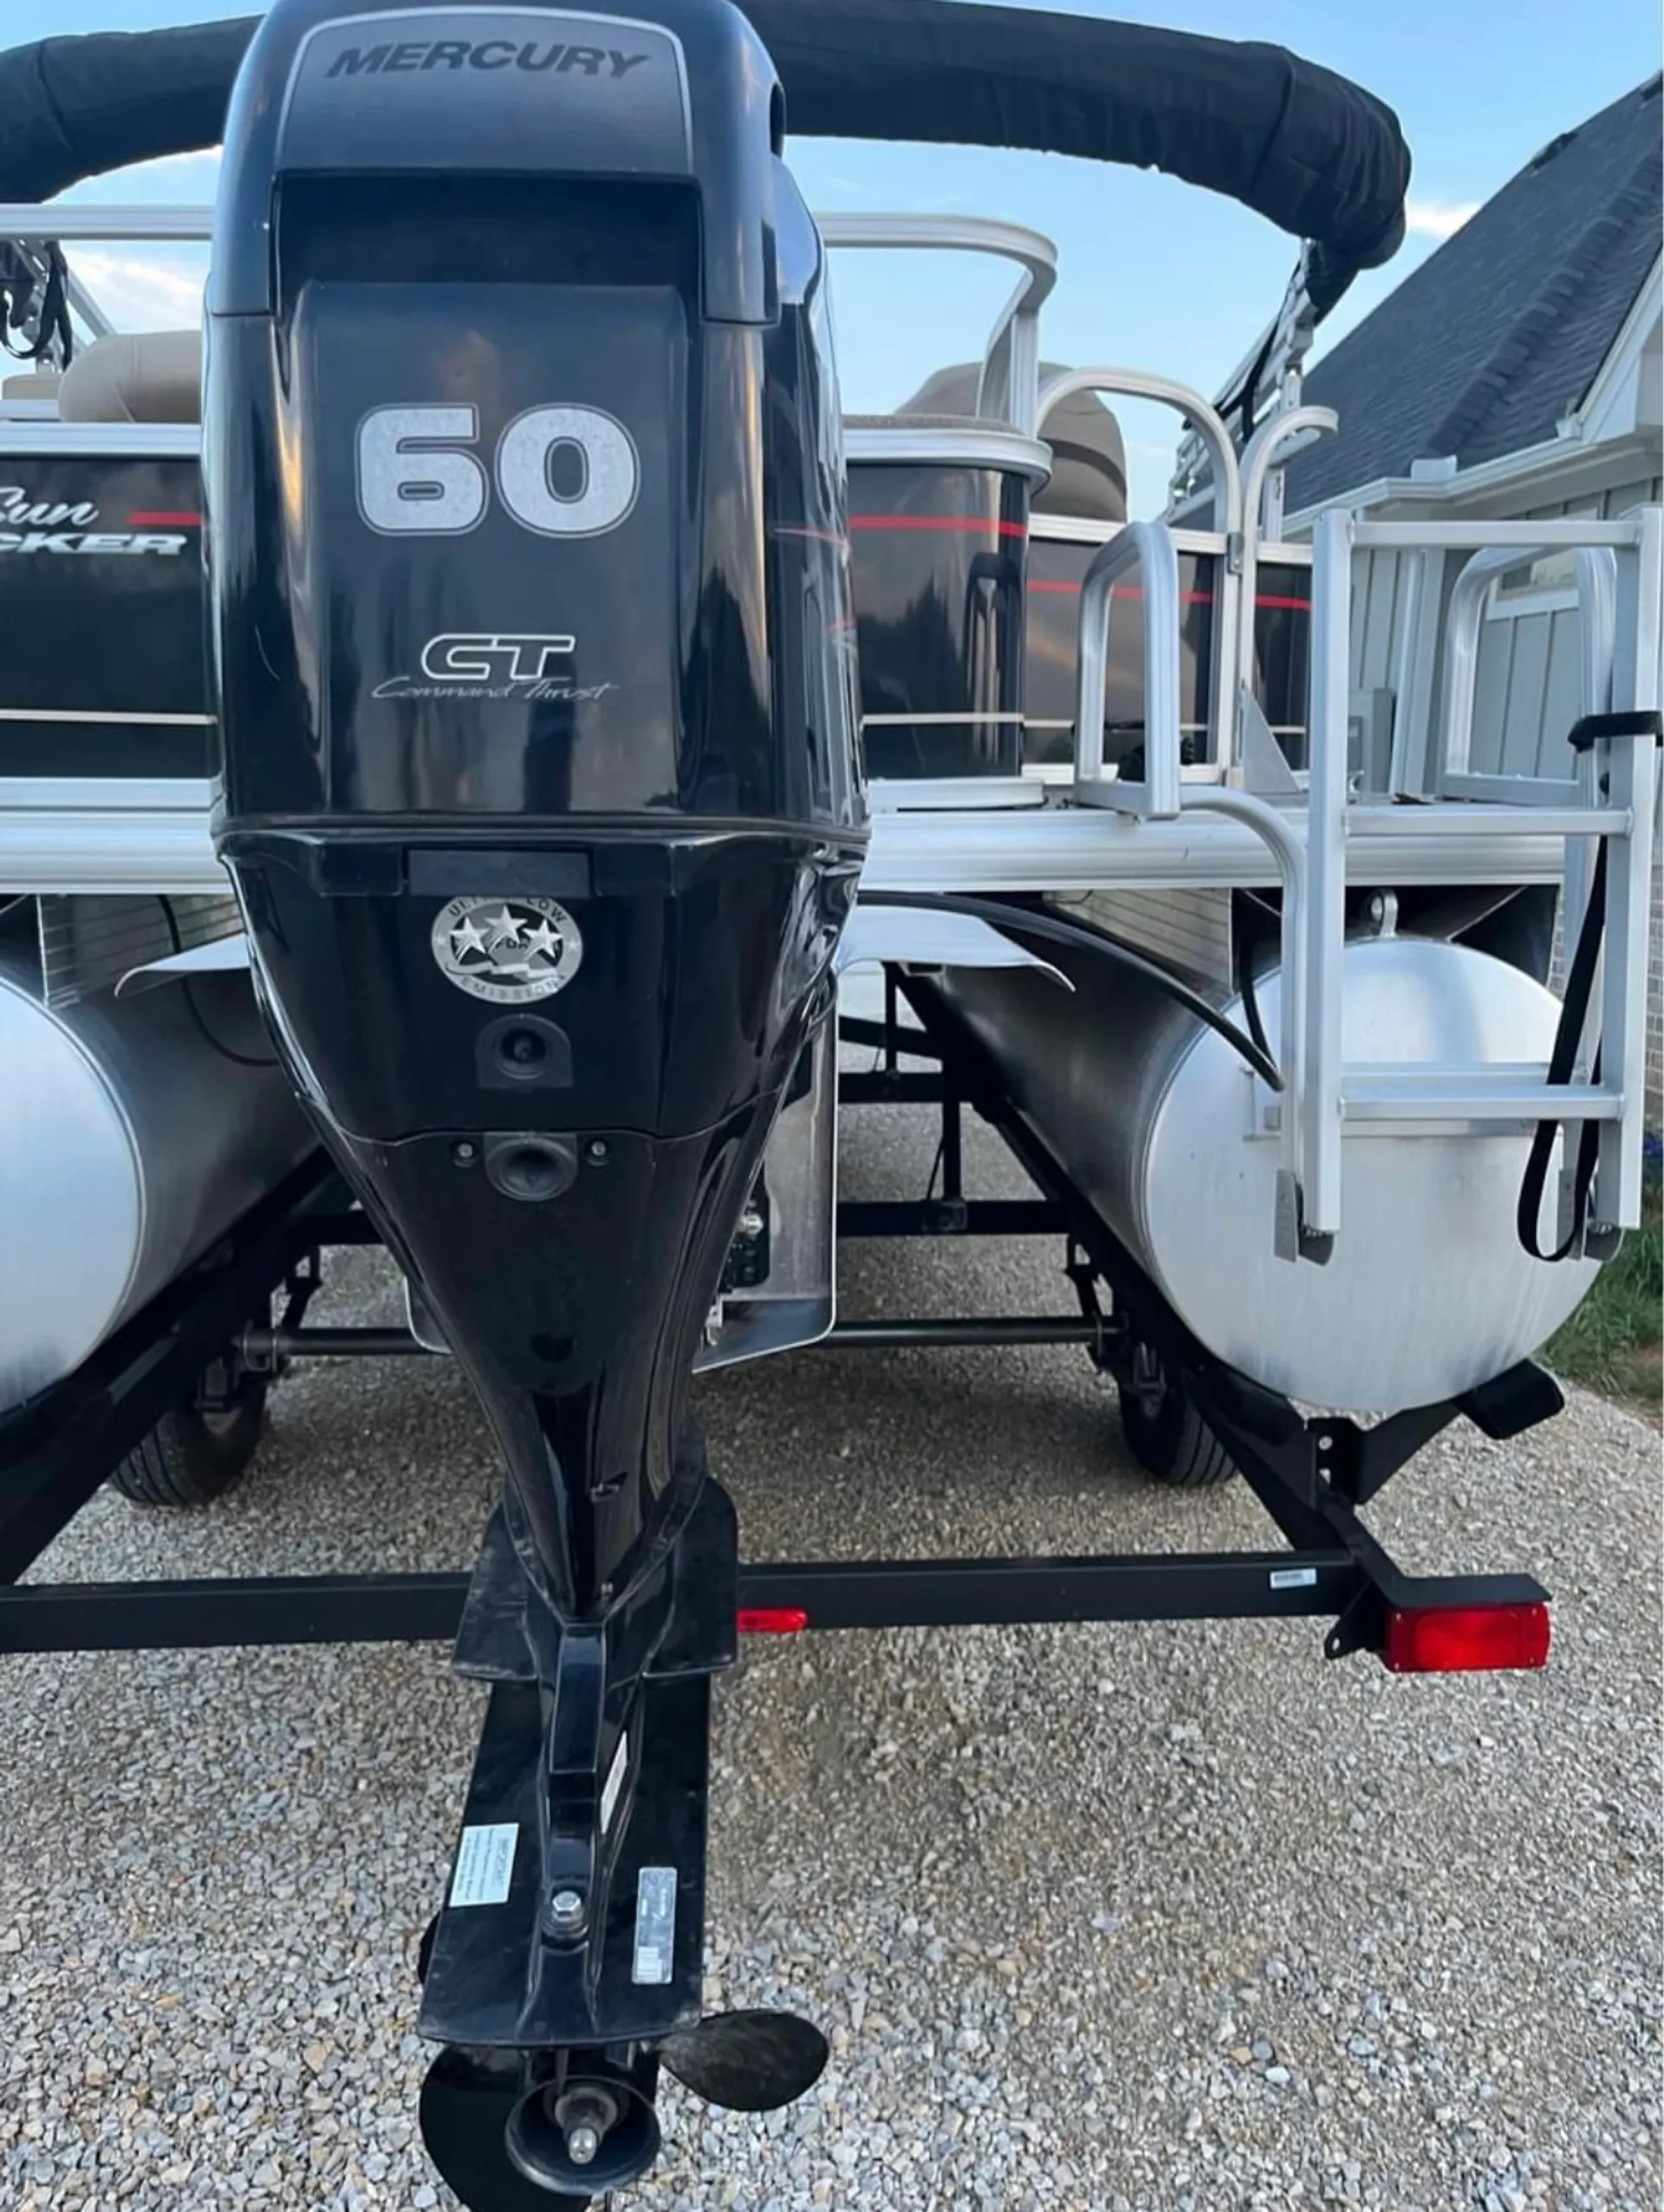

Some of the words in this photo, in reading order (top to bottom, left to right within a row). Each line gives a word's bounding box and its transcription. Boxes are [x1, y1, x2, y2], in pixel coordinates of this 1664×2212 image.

[325, 40, 651, 80] MERCURY
[354, 402, 641, 539] 60
[371, 676, 517, 699] Command
[517, 676, 620, 700] Thrust
[525, 895, 569, 923] LOW
